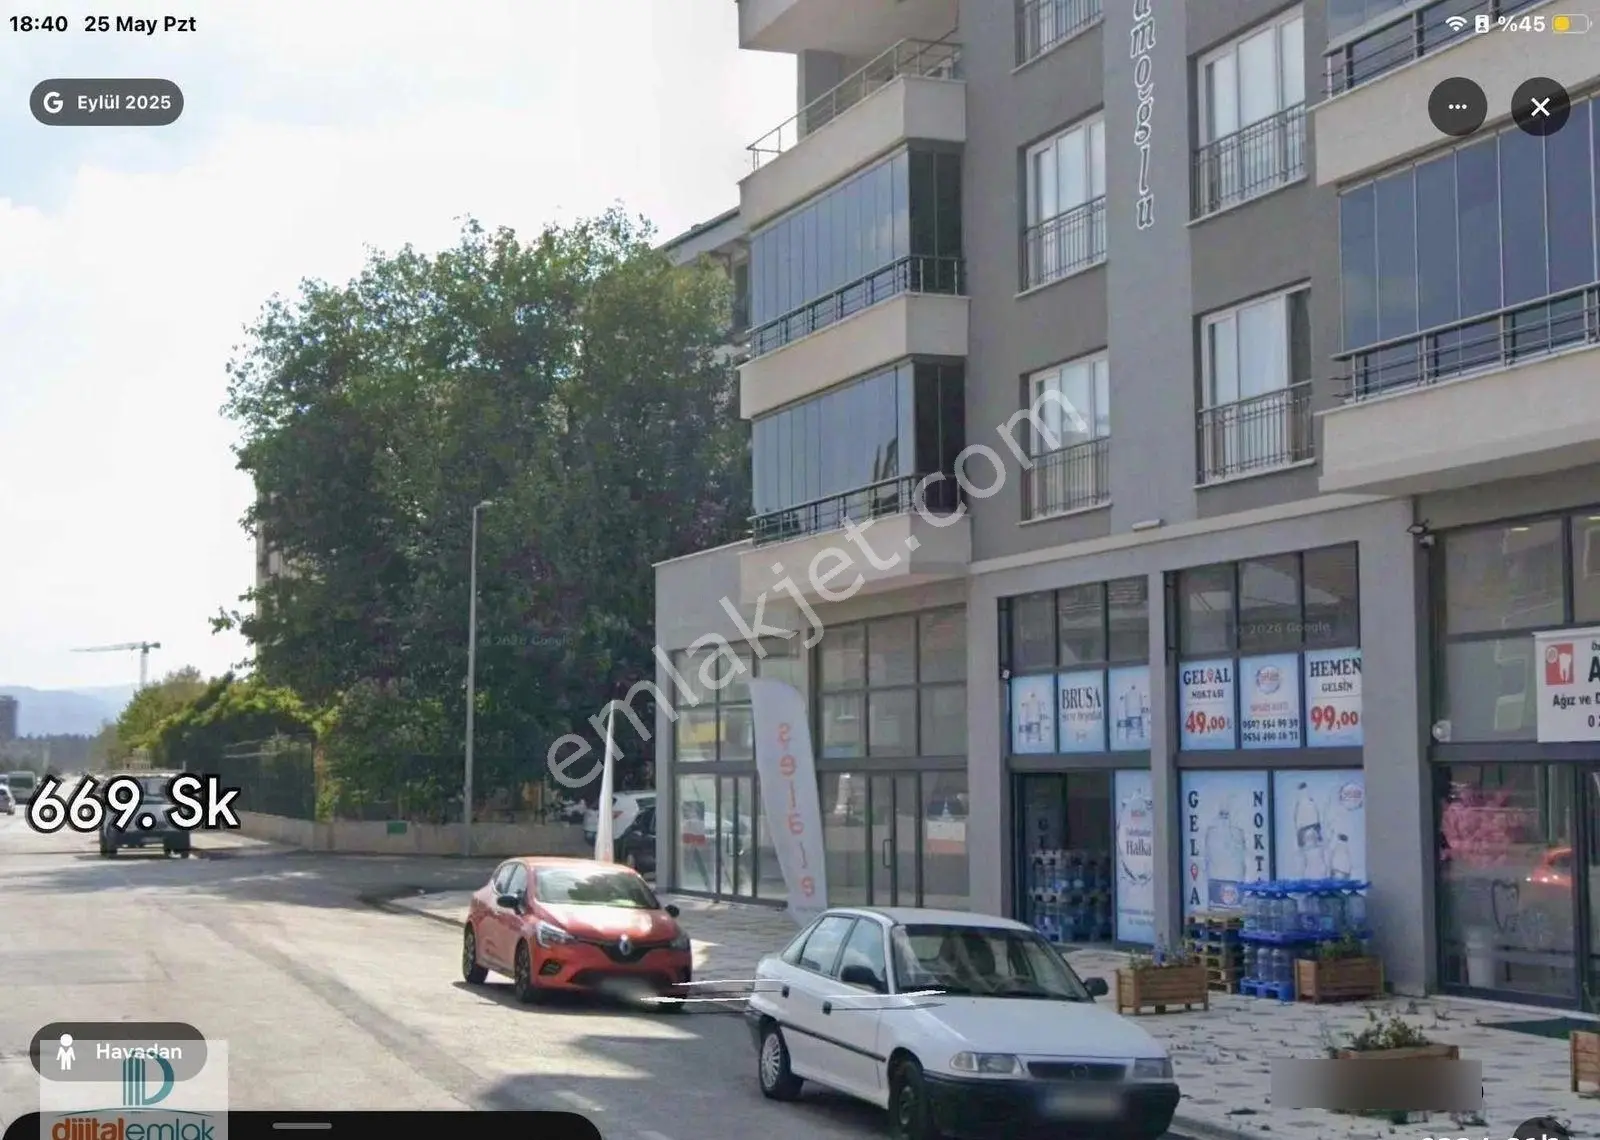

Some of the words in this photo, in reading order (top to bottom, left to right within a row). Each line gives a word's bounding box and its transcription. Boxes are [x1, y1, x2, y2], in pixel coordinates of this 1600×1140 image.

[1309, 658, 1362, 678] HEMEN
[1061, 687, 1102, 710] BRUSA
[1552, 694, 1576, 709] Ağız
[1579, 696, 1592, 706] ve
[1252, 790, 1265, 882] NOKT
